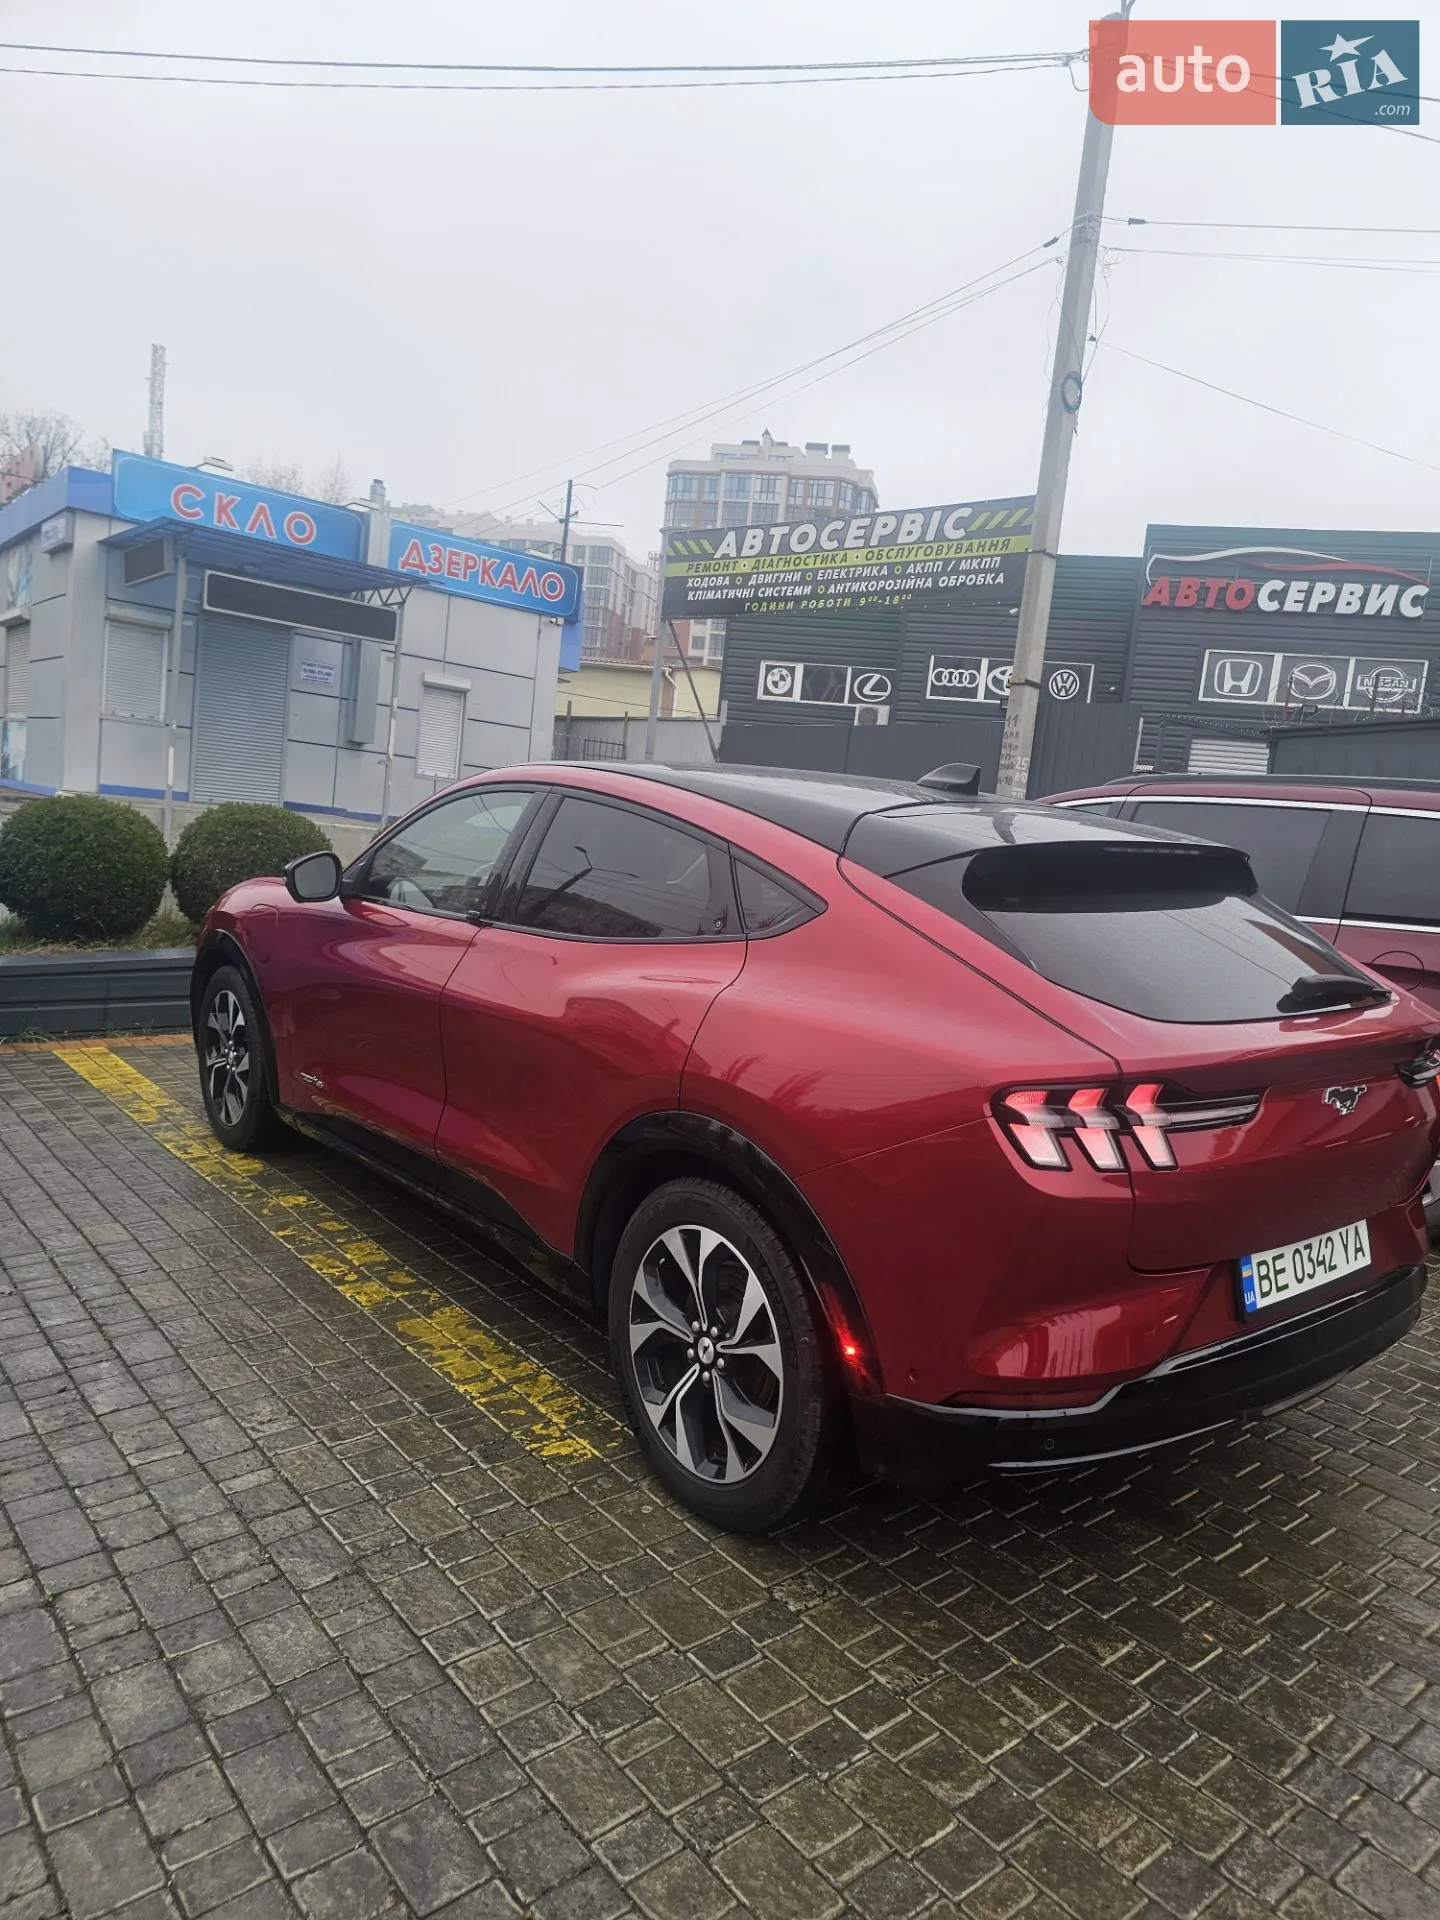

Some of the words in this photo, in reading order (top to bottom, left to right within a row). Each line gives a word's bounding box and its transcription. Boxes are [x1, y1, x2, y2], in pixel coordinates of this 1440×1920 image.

[171, 484, 317, 546] СКЛО
[713, 507, 973, 559] АВТОСЕРВІС
[399, 539, 565, 603] ДЗЕРКАЛО
[686, 560, 739, 574] РЕМОНТ
[751, 552, 848, 572] ДІАГНОСТИКА
[865, 538, 1012, 561] ОБСЛУГОВУВАННЯ
[686, 576, 730, 588] ХОДОВА
[748, 571, 801, 586] ДВИГУНИ
[817, 565, 888, 581] ЕЛЕКТРИКА
[906, 561, 944, 574] АКПП
[959, 556, 1001, 570] МКПП
[687, 587, 754, 601] КЛІМАТИЧНІ
[758, 585, 812, 598] СИСТЕМИ
[827, 576, 932, 594] АНТИКОРОЗІЙНА
[938, 573, 1005, 588] ОБРОБКА
[744, 600, 794, 612] ГОДИНИ
[801, 598, 852, 609] РОБОТИ
[1142, 576, 1430, 618] АВТОСЕРВИС
[1256, 1252, 1289, 1299] BE
[1292, 1235, 1338, 1285] 0342
[1338, 1225, 1366, 1265] YA
[1244, 1291, 1256, 1305] UA
